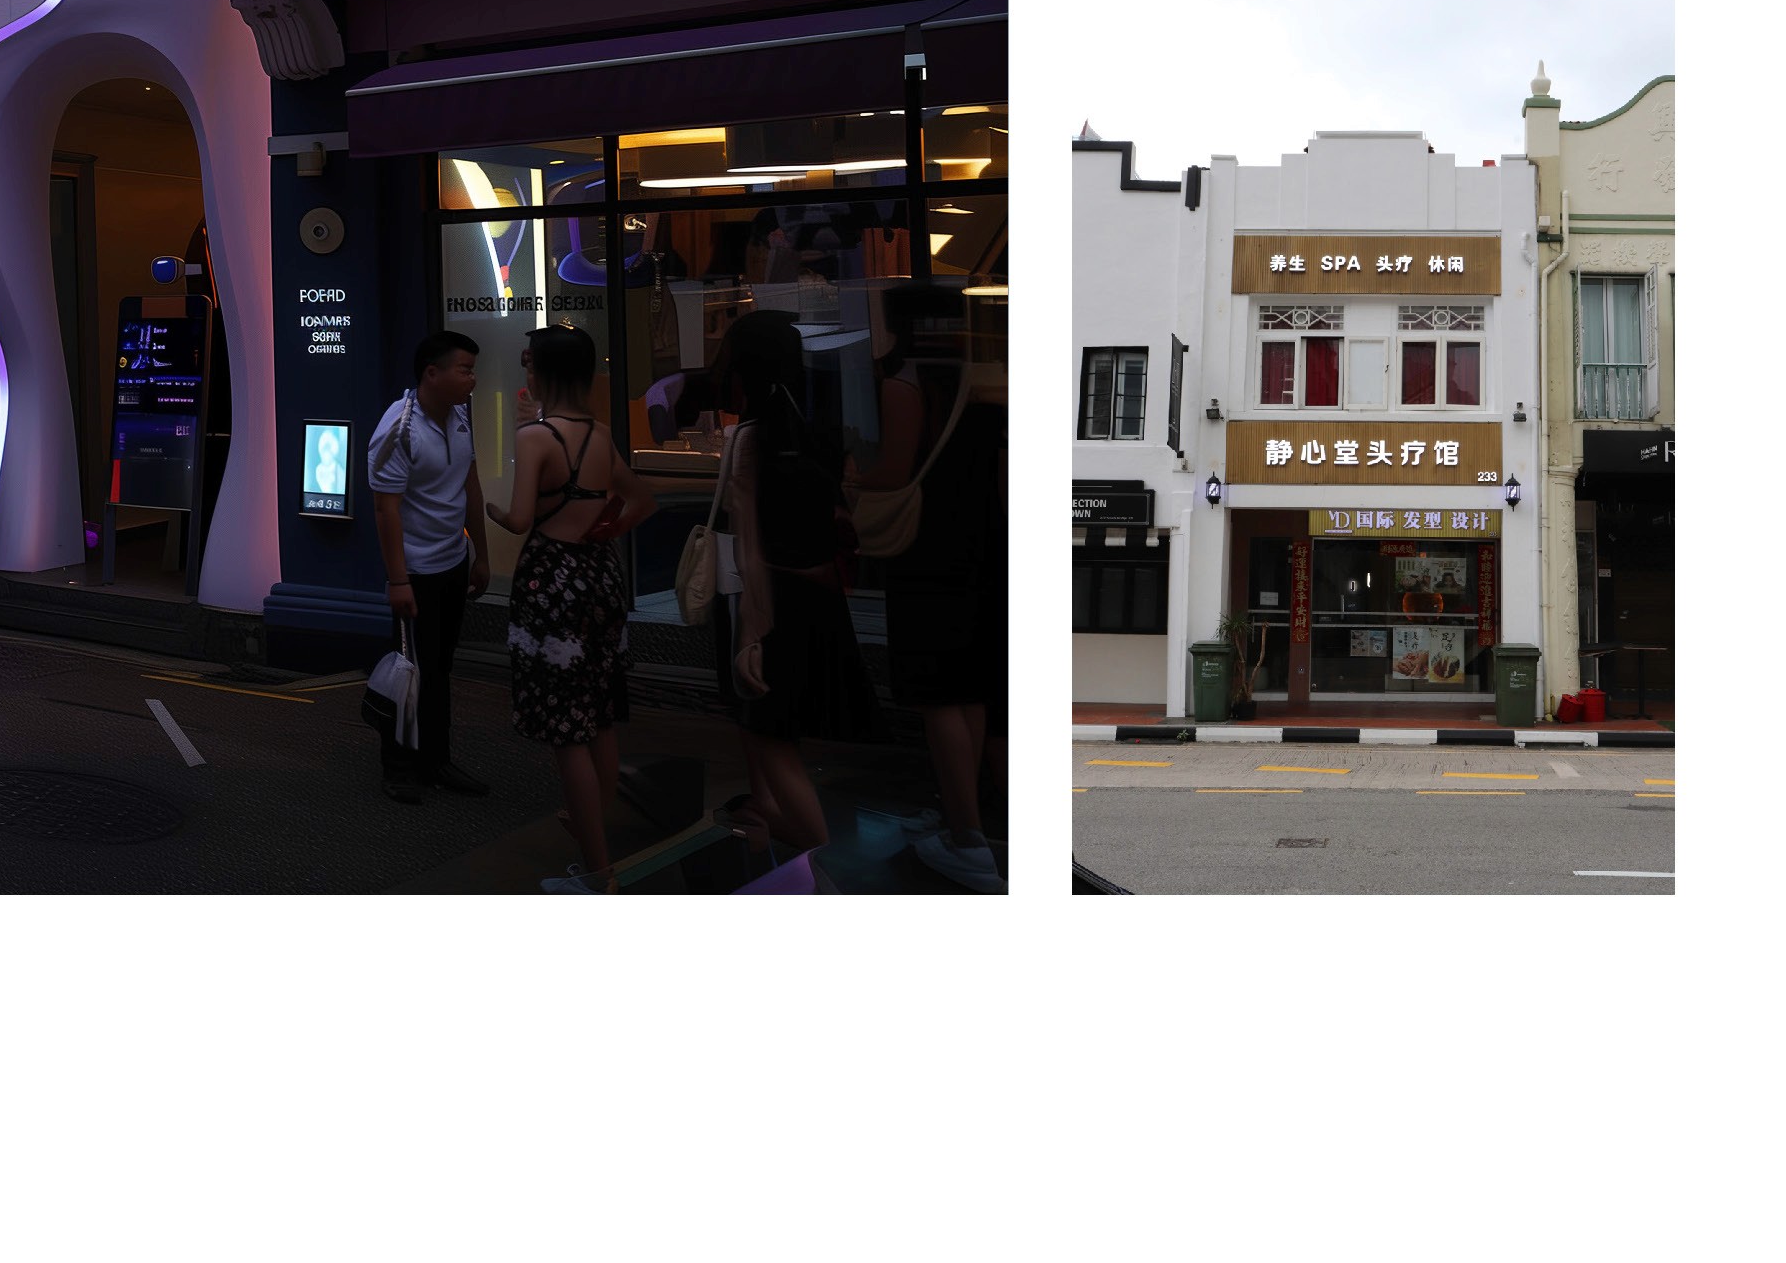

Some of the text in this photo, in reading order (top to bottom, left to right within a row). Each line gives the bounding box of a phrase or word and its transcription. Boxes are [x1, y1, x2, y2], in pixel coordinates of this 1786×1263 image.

[1270, 255, 1464, 272] 养生 SPA 头疗 休闲
[1266, 440, 1459, 466] 静心堂头疗馆
[1477, 471, 1498, 482] 233
[1357, 511, 1394, 529] 国际
[1402, 511, 1442, 529] 发型
[1451, 511, 1489, 530] 设计
